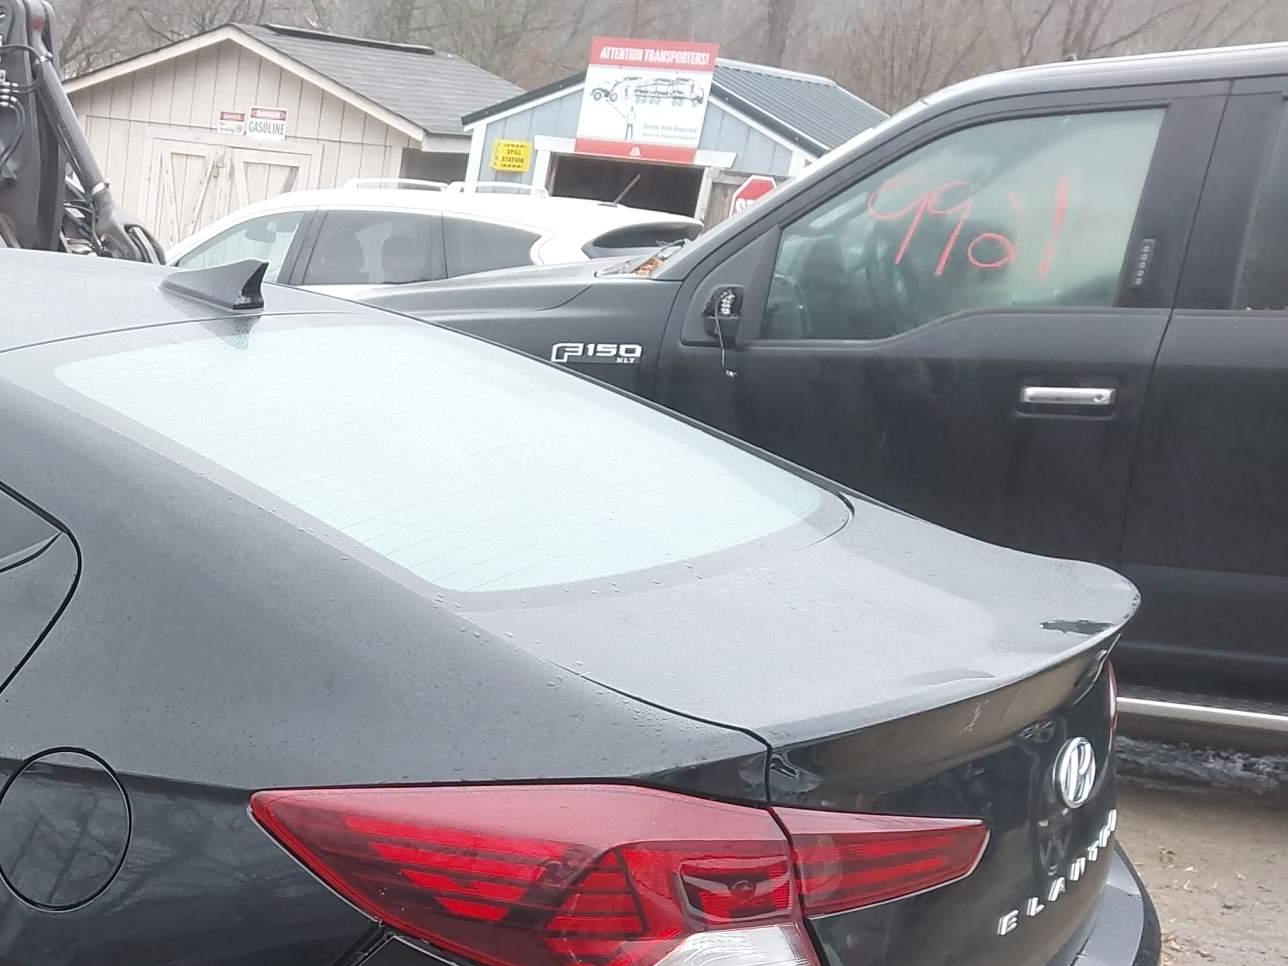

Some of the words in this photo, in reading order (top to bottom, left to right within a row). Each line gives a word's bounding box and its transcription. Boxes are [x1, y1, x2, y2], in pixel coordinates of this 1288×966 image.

[599, 46, 644, 62] ATTENTION
[643, 48, 711, 65] TRANSPORTERS!
[248, 120, 285, 136] GASOLINE
[506, 148, 522, 156] SPILL
[501, 155, 525, 164] STATION
[550, 342, 643, 363] F150
[615, 356, 636, 364] XLT
